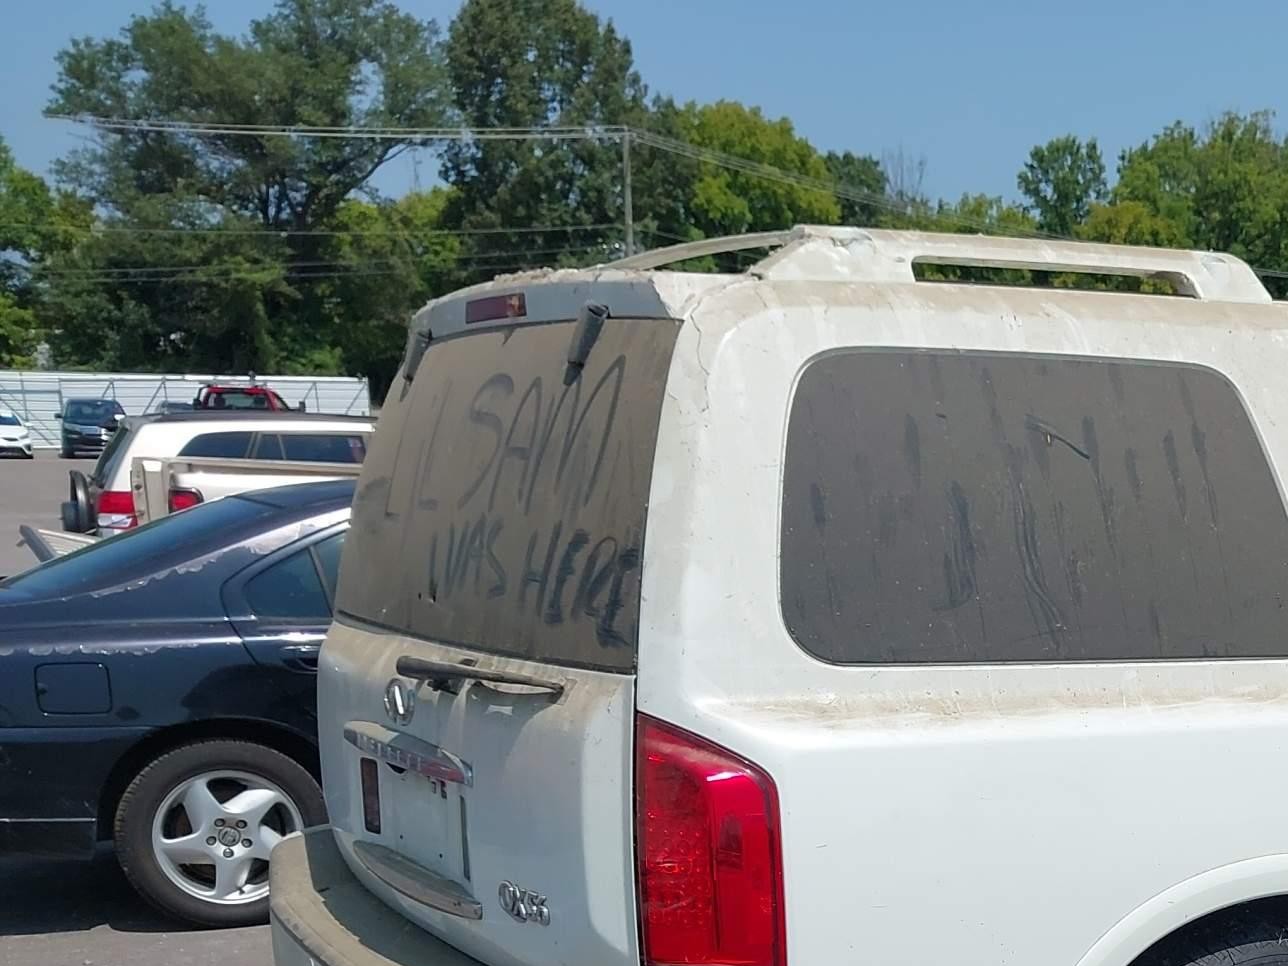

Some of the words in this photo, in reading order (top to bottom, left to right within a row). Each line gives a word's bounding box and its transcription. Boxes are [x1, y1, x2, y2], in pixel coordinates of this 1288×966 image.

[457, 353, 628, 517] SAM
[518, 519, 641, 649] HERE
[498, 880, 550, 926] QX56
